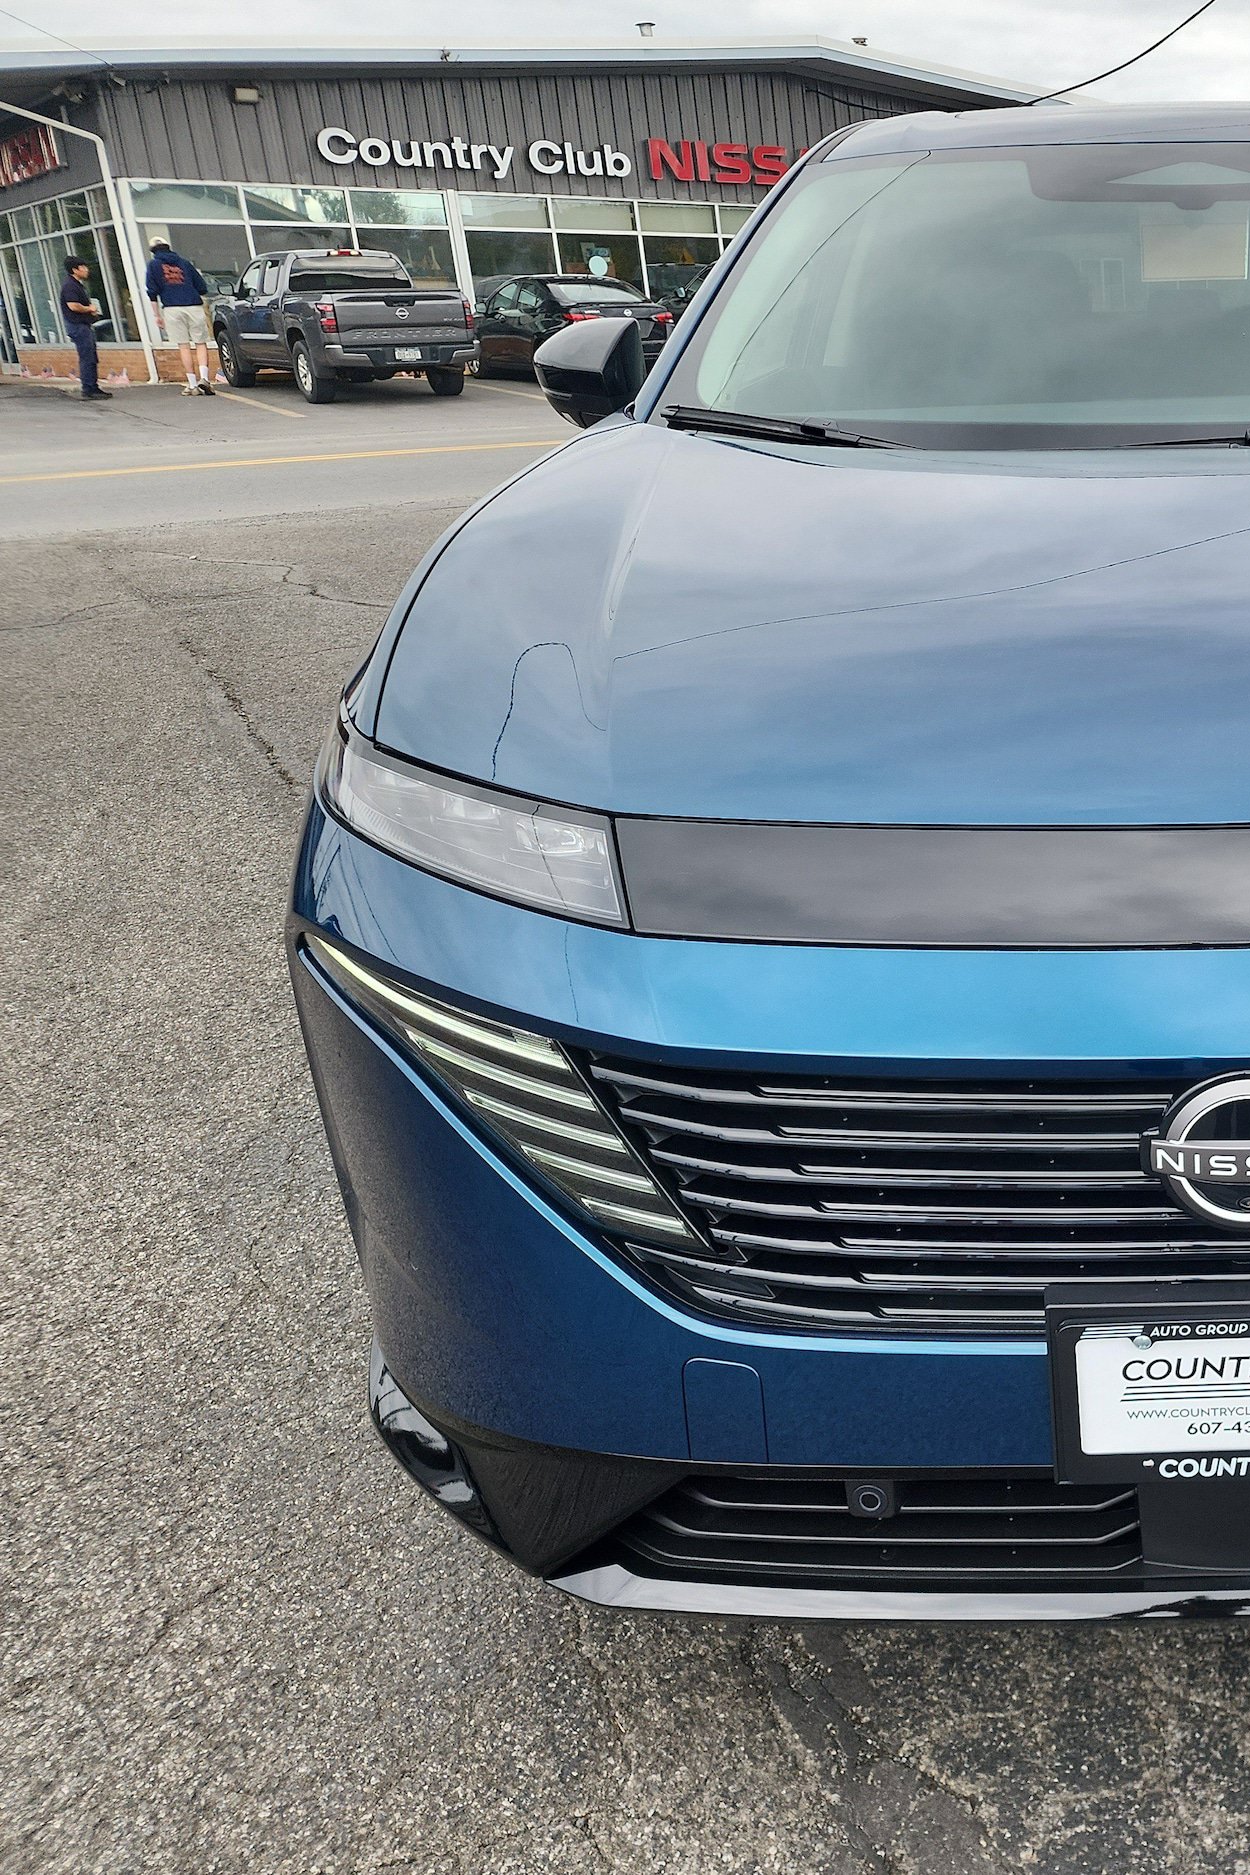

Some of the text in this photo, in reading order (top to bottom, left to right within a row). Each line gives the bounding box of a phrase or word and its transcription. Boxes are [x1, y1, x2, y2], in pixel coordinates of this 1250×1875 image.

[316, 127, 808, 185] Country Club NISS
[352, 328, 457, 340] FRONTIER
[1150, 1325, 1192, 1338] AUTO
[1195, 1323, 1249, 1335] GROUP
